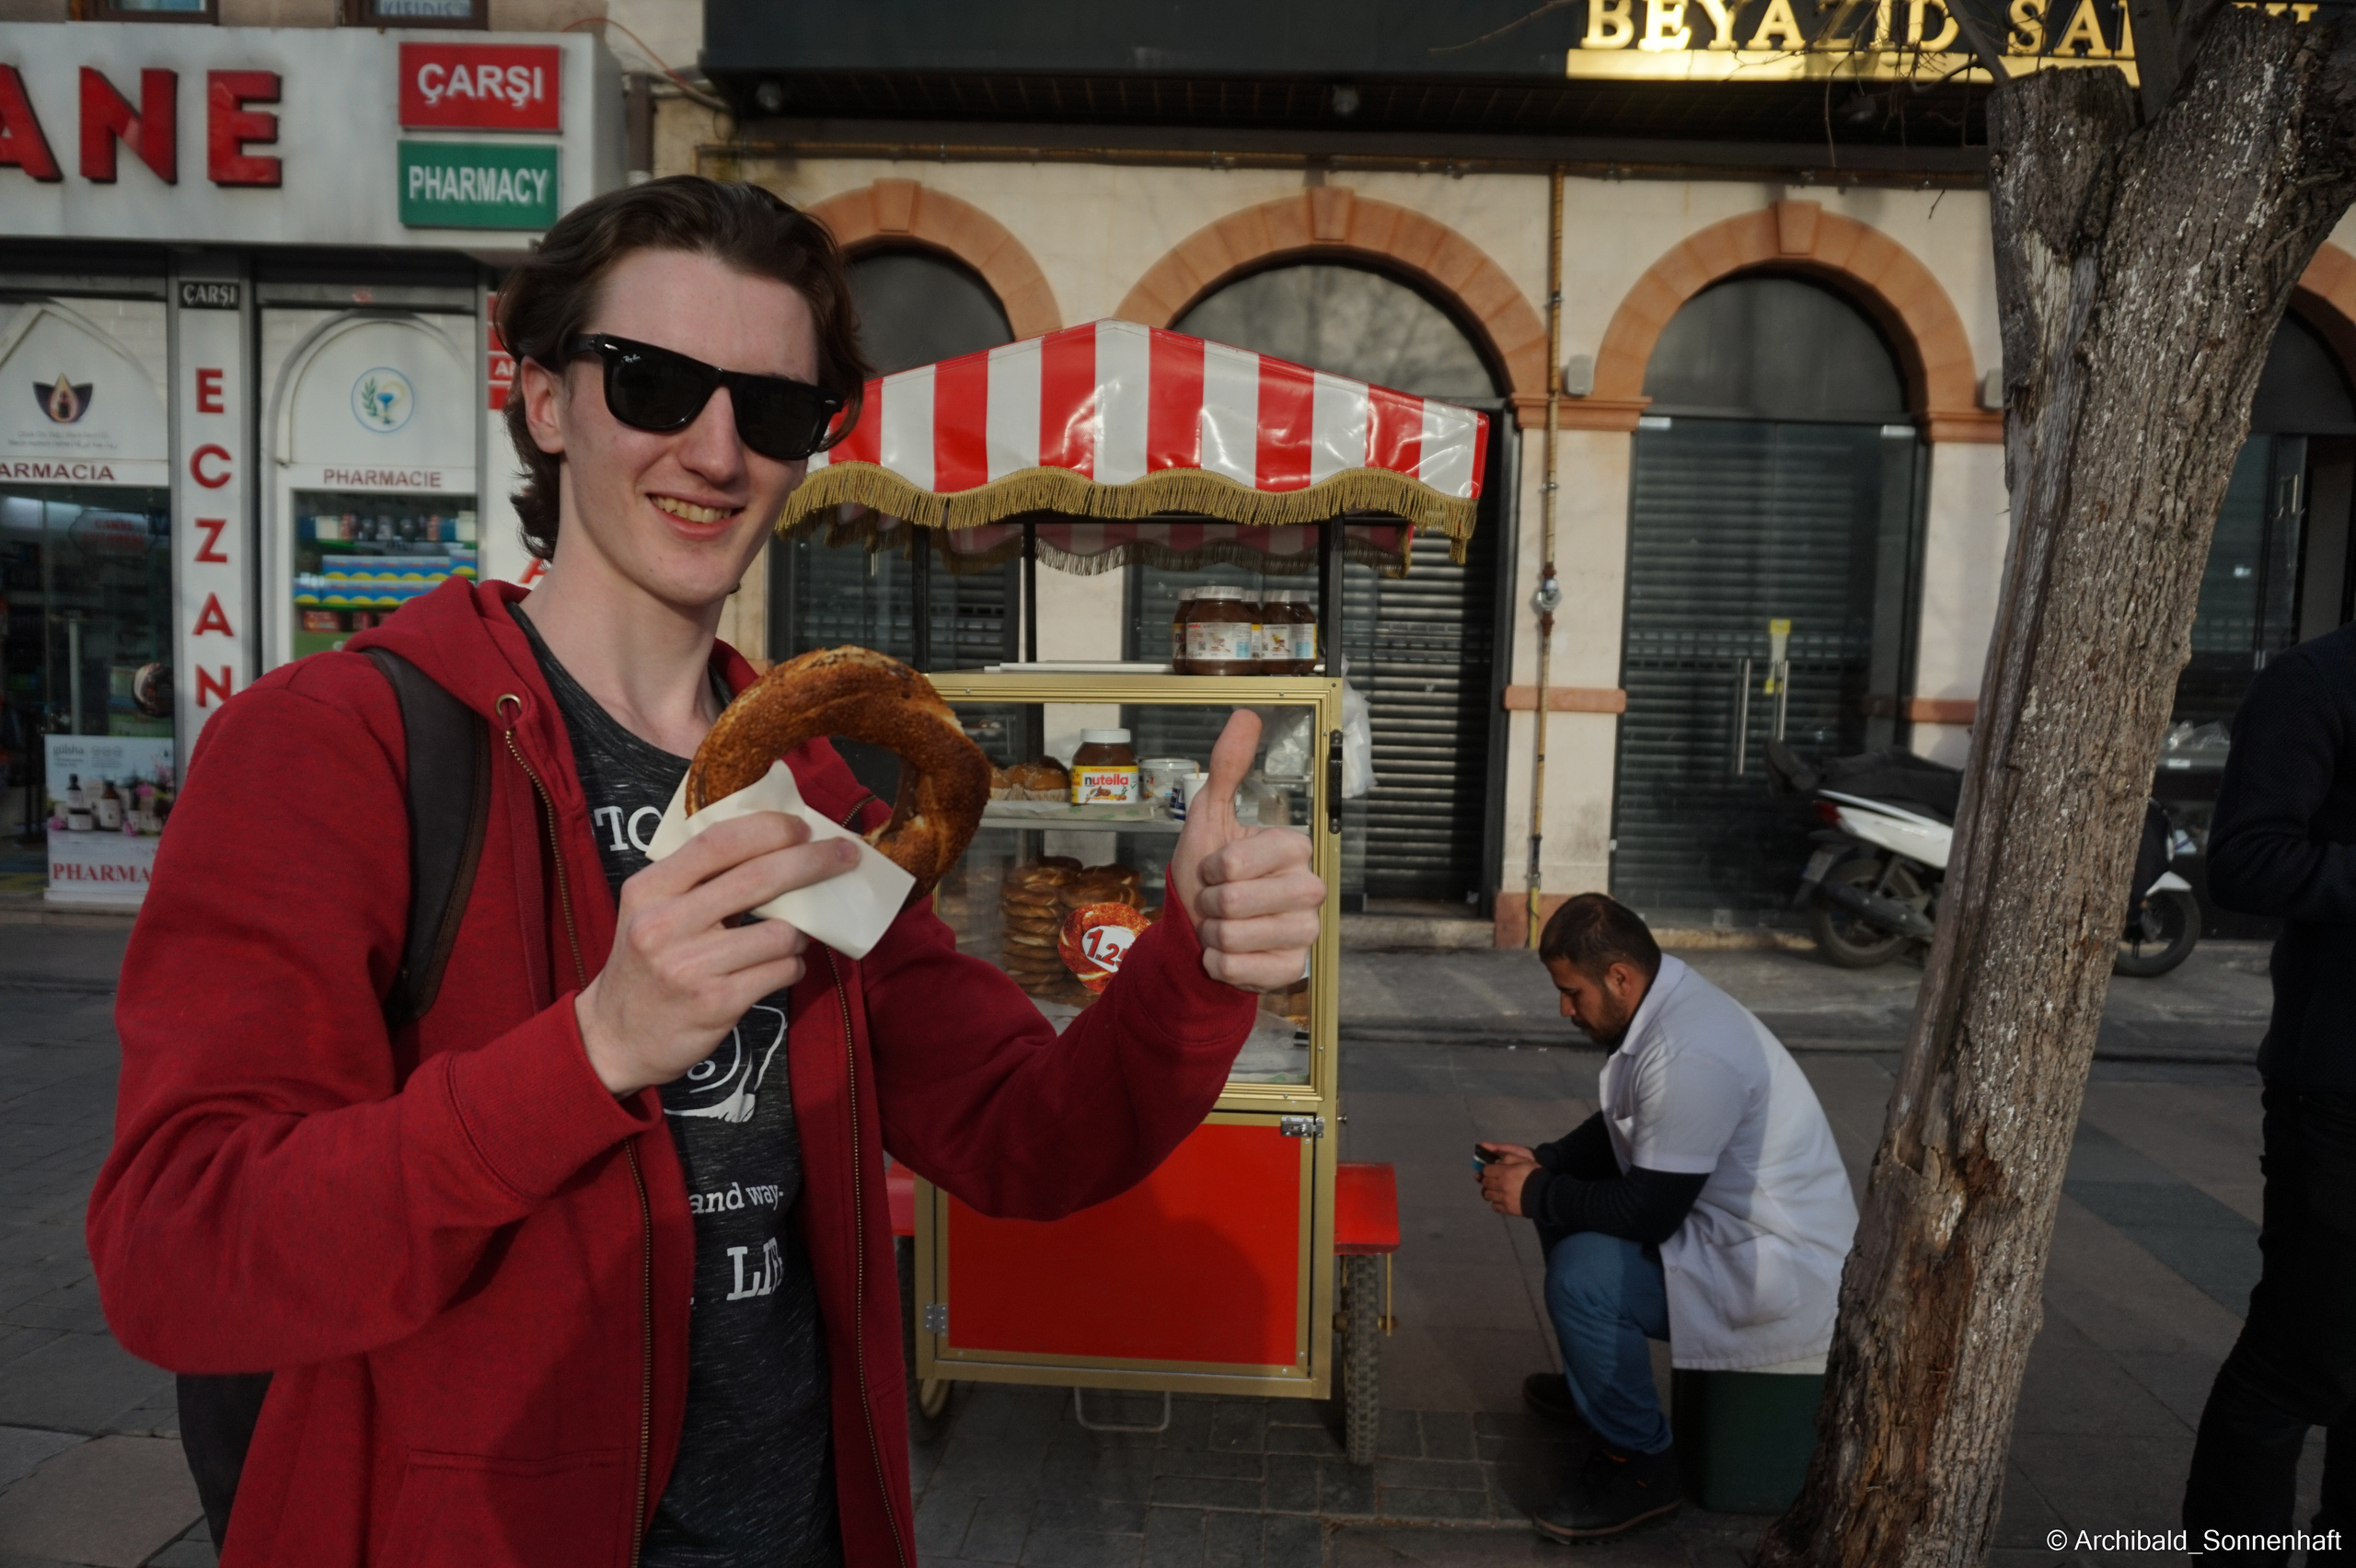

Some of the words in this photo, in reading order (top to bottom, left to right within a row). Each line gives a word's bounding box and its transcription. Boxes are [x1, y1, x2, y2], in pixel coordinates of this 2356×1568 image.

[1580, 0, 1959, 52] BEYAZID
[417, 63, 545, 108] ÇARŞI
[408, 165, 549, 204] PHARMACY
[182, 283, 235, 306] ÇARŞI
[0, 462, 115, 480] ARMACIA
[323, 467, 442, 488] PHARMACIE
[1084, 773, 1129, 786] nutella
[52, 861, 152, 883] PHARMA
[689, 1182, 745, 1215] and
